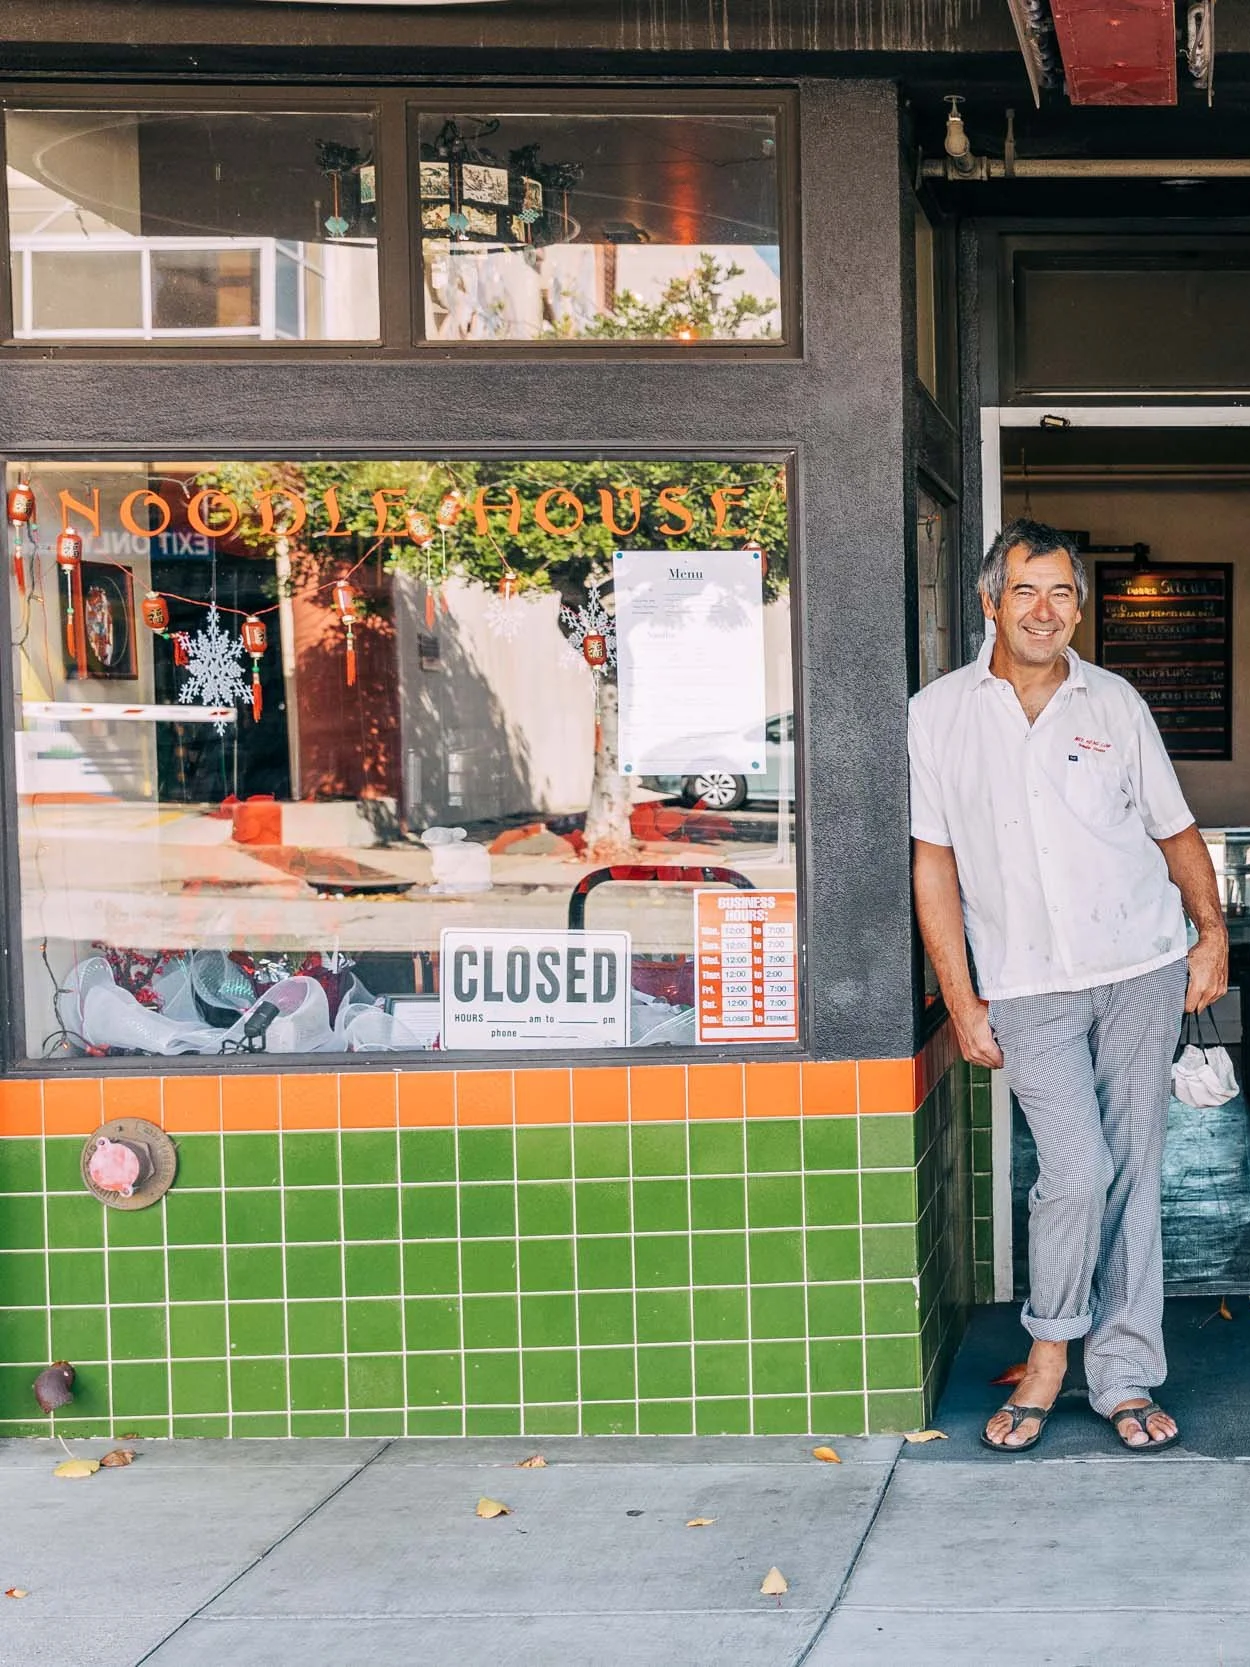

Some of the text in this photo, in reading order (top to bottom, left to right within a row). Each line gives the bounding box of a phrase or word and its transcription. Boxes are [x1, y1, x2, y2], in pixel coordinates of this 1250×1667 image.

[59, 486, 748, 537] NOODLE HOUSE
[669, 567, 704, 580] Menu
[718, 896, 776, 909] BUSINESS
[725, 909, 769, 921] HOURS:
[753, 927, 762, 935] to
[753, 941, 762, 949] to
[753, 956, 762, 964] to
[453, 944, 618, 1004] CLOSED
[726, 970, 746, 978] 12:00
[754, 970, 762, 979] to
[766, 970, 783, 978] 2:00
[727, 985, 747, 993] 12:00
[754, 985, 763, 994] to
[769, 985, 787, 993] 7:00
[728, 999, 748, 1007] 12:00
[754, 999, 763, 1008] to
[769, 999, 787, 1007] 7:00
[454, 1013, 484, 1023] HOURS
[546, 1015, 555, 1023] to
[602, 1016, 616, 1025] pm
[754, 1014, 763, 1023] to
[491, 1029, 517, 1038] phone
